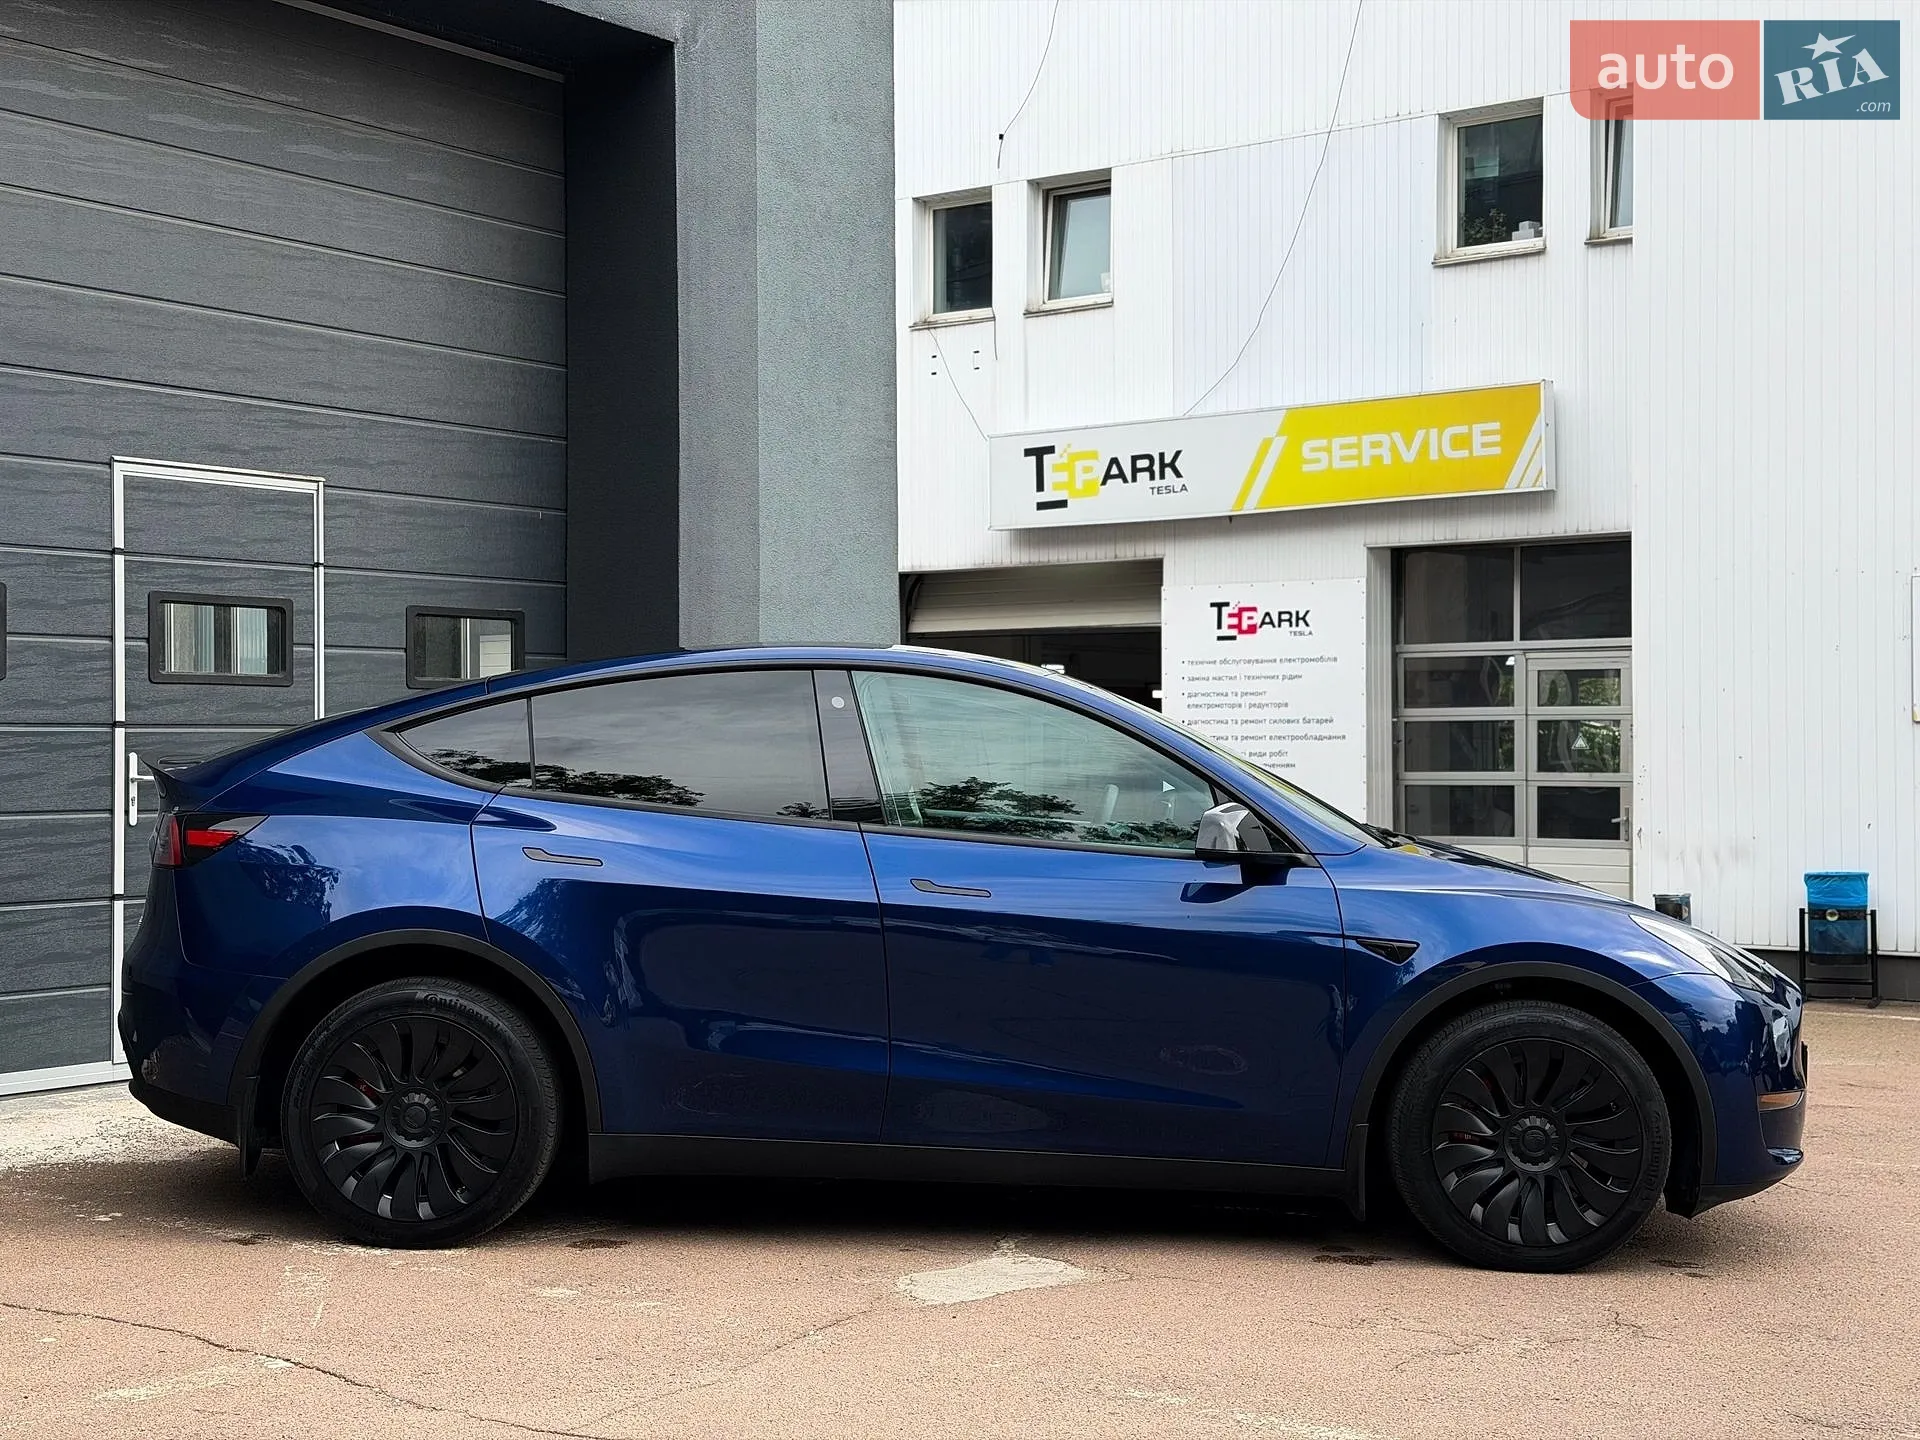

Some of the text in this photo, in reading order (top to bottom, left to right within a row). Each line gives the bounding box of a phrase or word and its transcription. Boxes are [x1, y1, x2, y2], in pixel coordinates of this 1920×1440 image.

[1300, 422, 1502, 473] SERVICE
[1149, 483, 1189, 496] TESLA
[1240, 718, 1266, 726] ремонт
